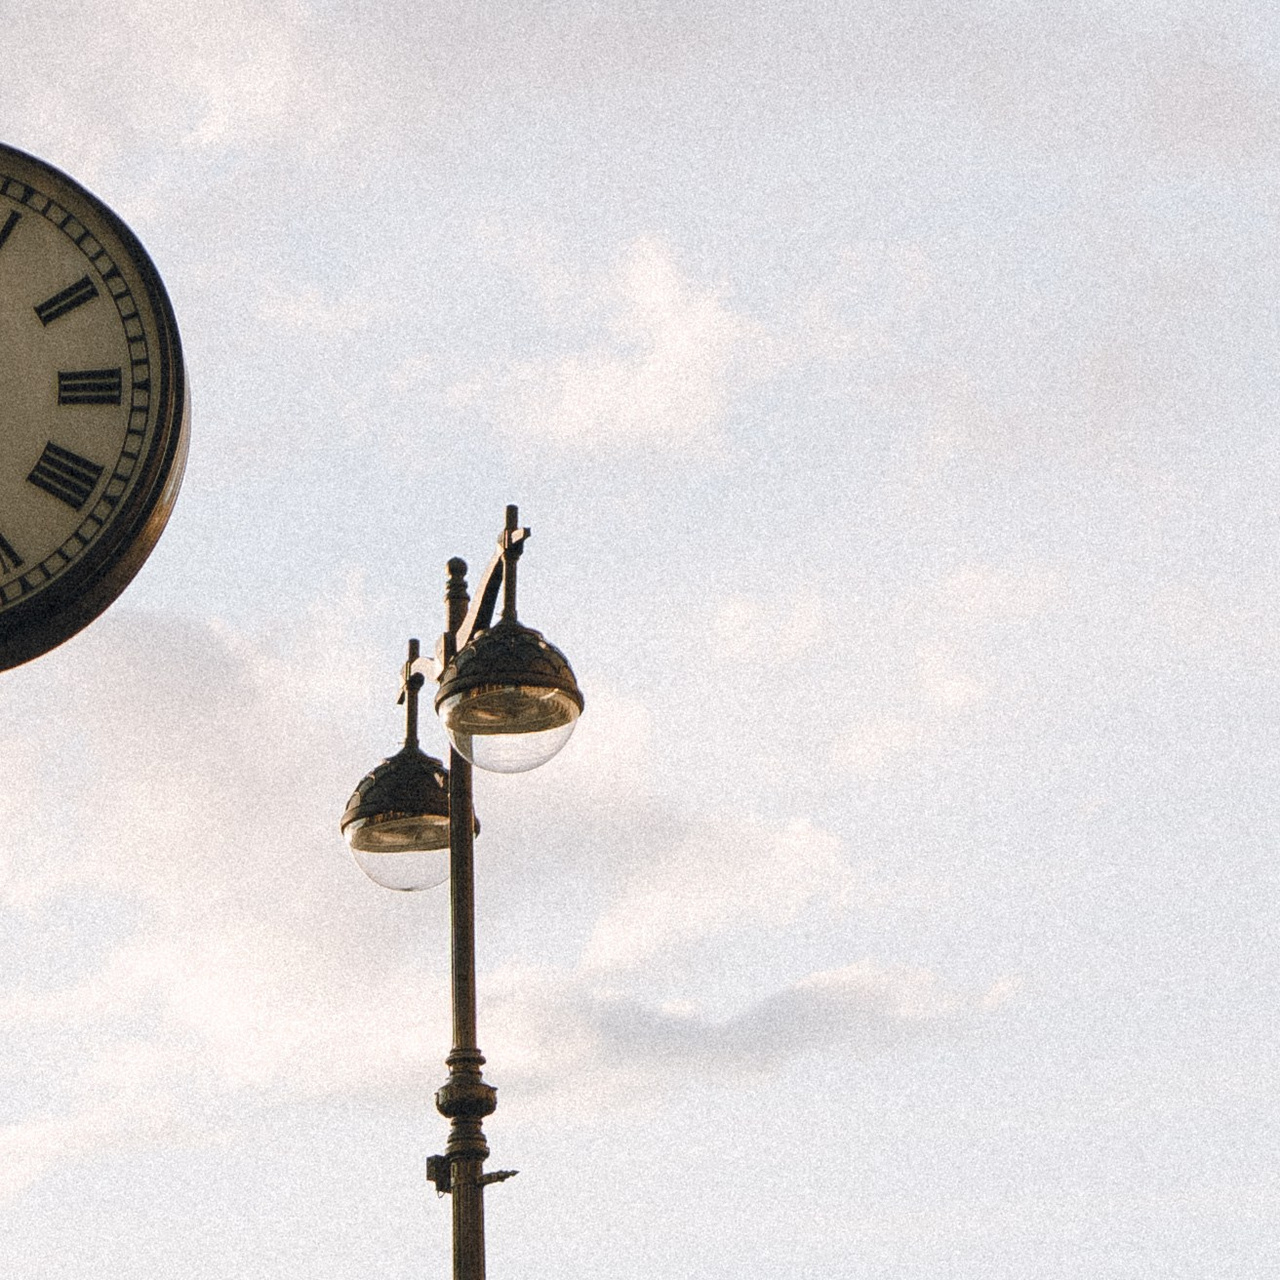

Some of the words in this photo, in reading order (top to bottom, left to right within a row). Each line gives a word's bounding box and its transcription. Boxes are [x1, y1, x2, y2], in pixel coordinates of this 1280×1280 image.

[34, 274, 100, 327] II
[57, 368, 122, 406] III
[26, 441, 105, 511] IIII
